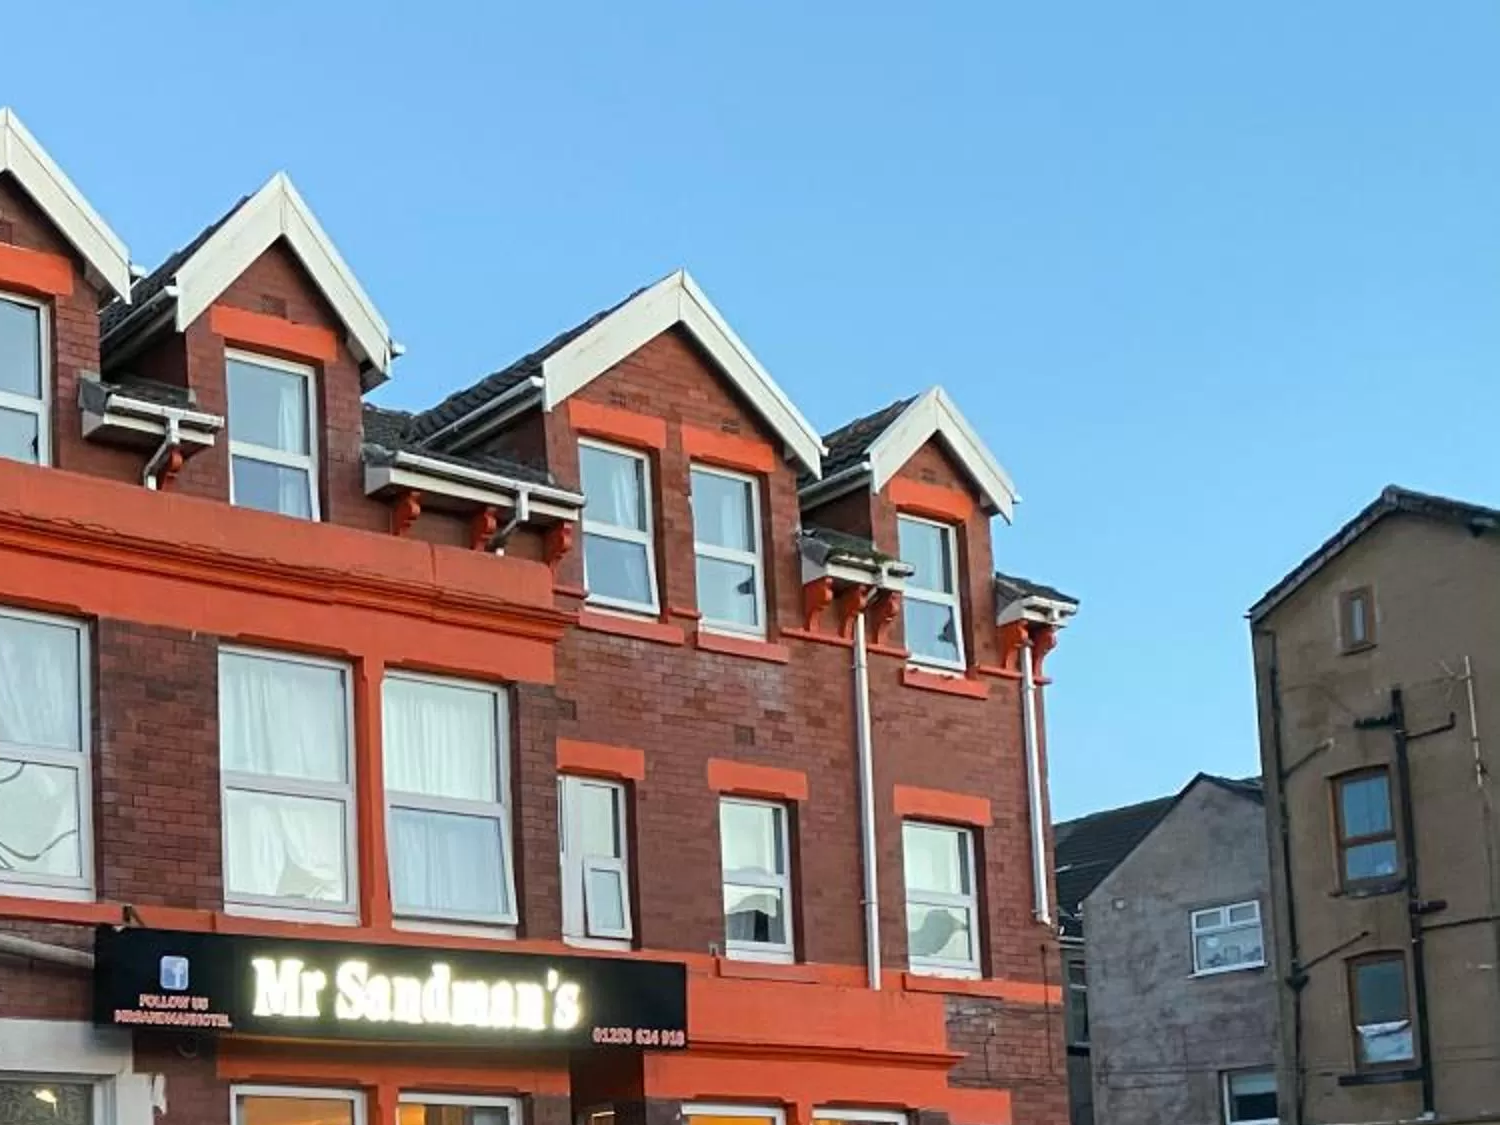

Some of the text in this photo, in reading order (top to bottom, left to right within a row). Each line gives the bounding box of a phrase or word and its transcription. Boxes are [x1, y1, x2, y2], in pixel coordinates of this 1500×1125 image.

[139, 994, 191, 1009] FOLLOW
[252, 957, 581, 1031] Mr Sandman's
